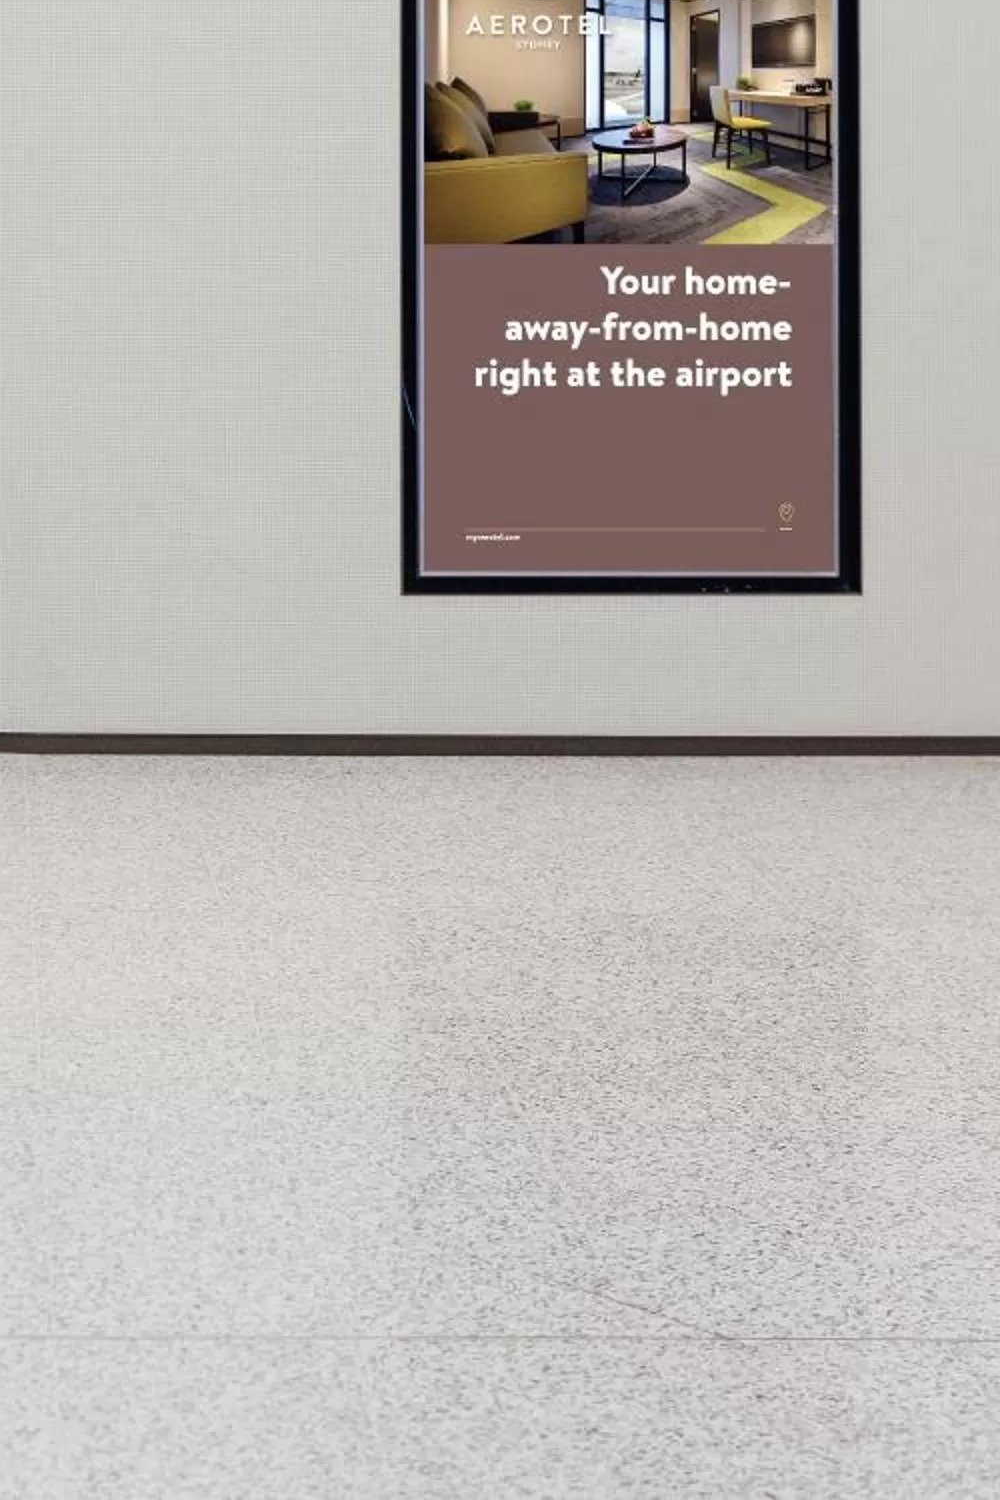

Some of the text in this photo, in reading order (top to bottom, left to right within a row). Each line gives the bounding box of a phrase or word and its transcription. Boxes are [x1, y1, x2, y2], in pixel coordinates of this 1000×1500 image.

[466, 14, 612, 36] AEROTEL
[600, 266, 791, 295] Your home-
[505, 312, 792, 349] away-from-home
[475, 359, 792, 397] right at the airport
